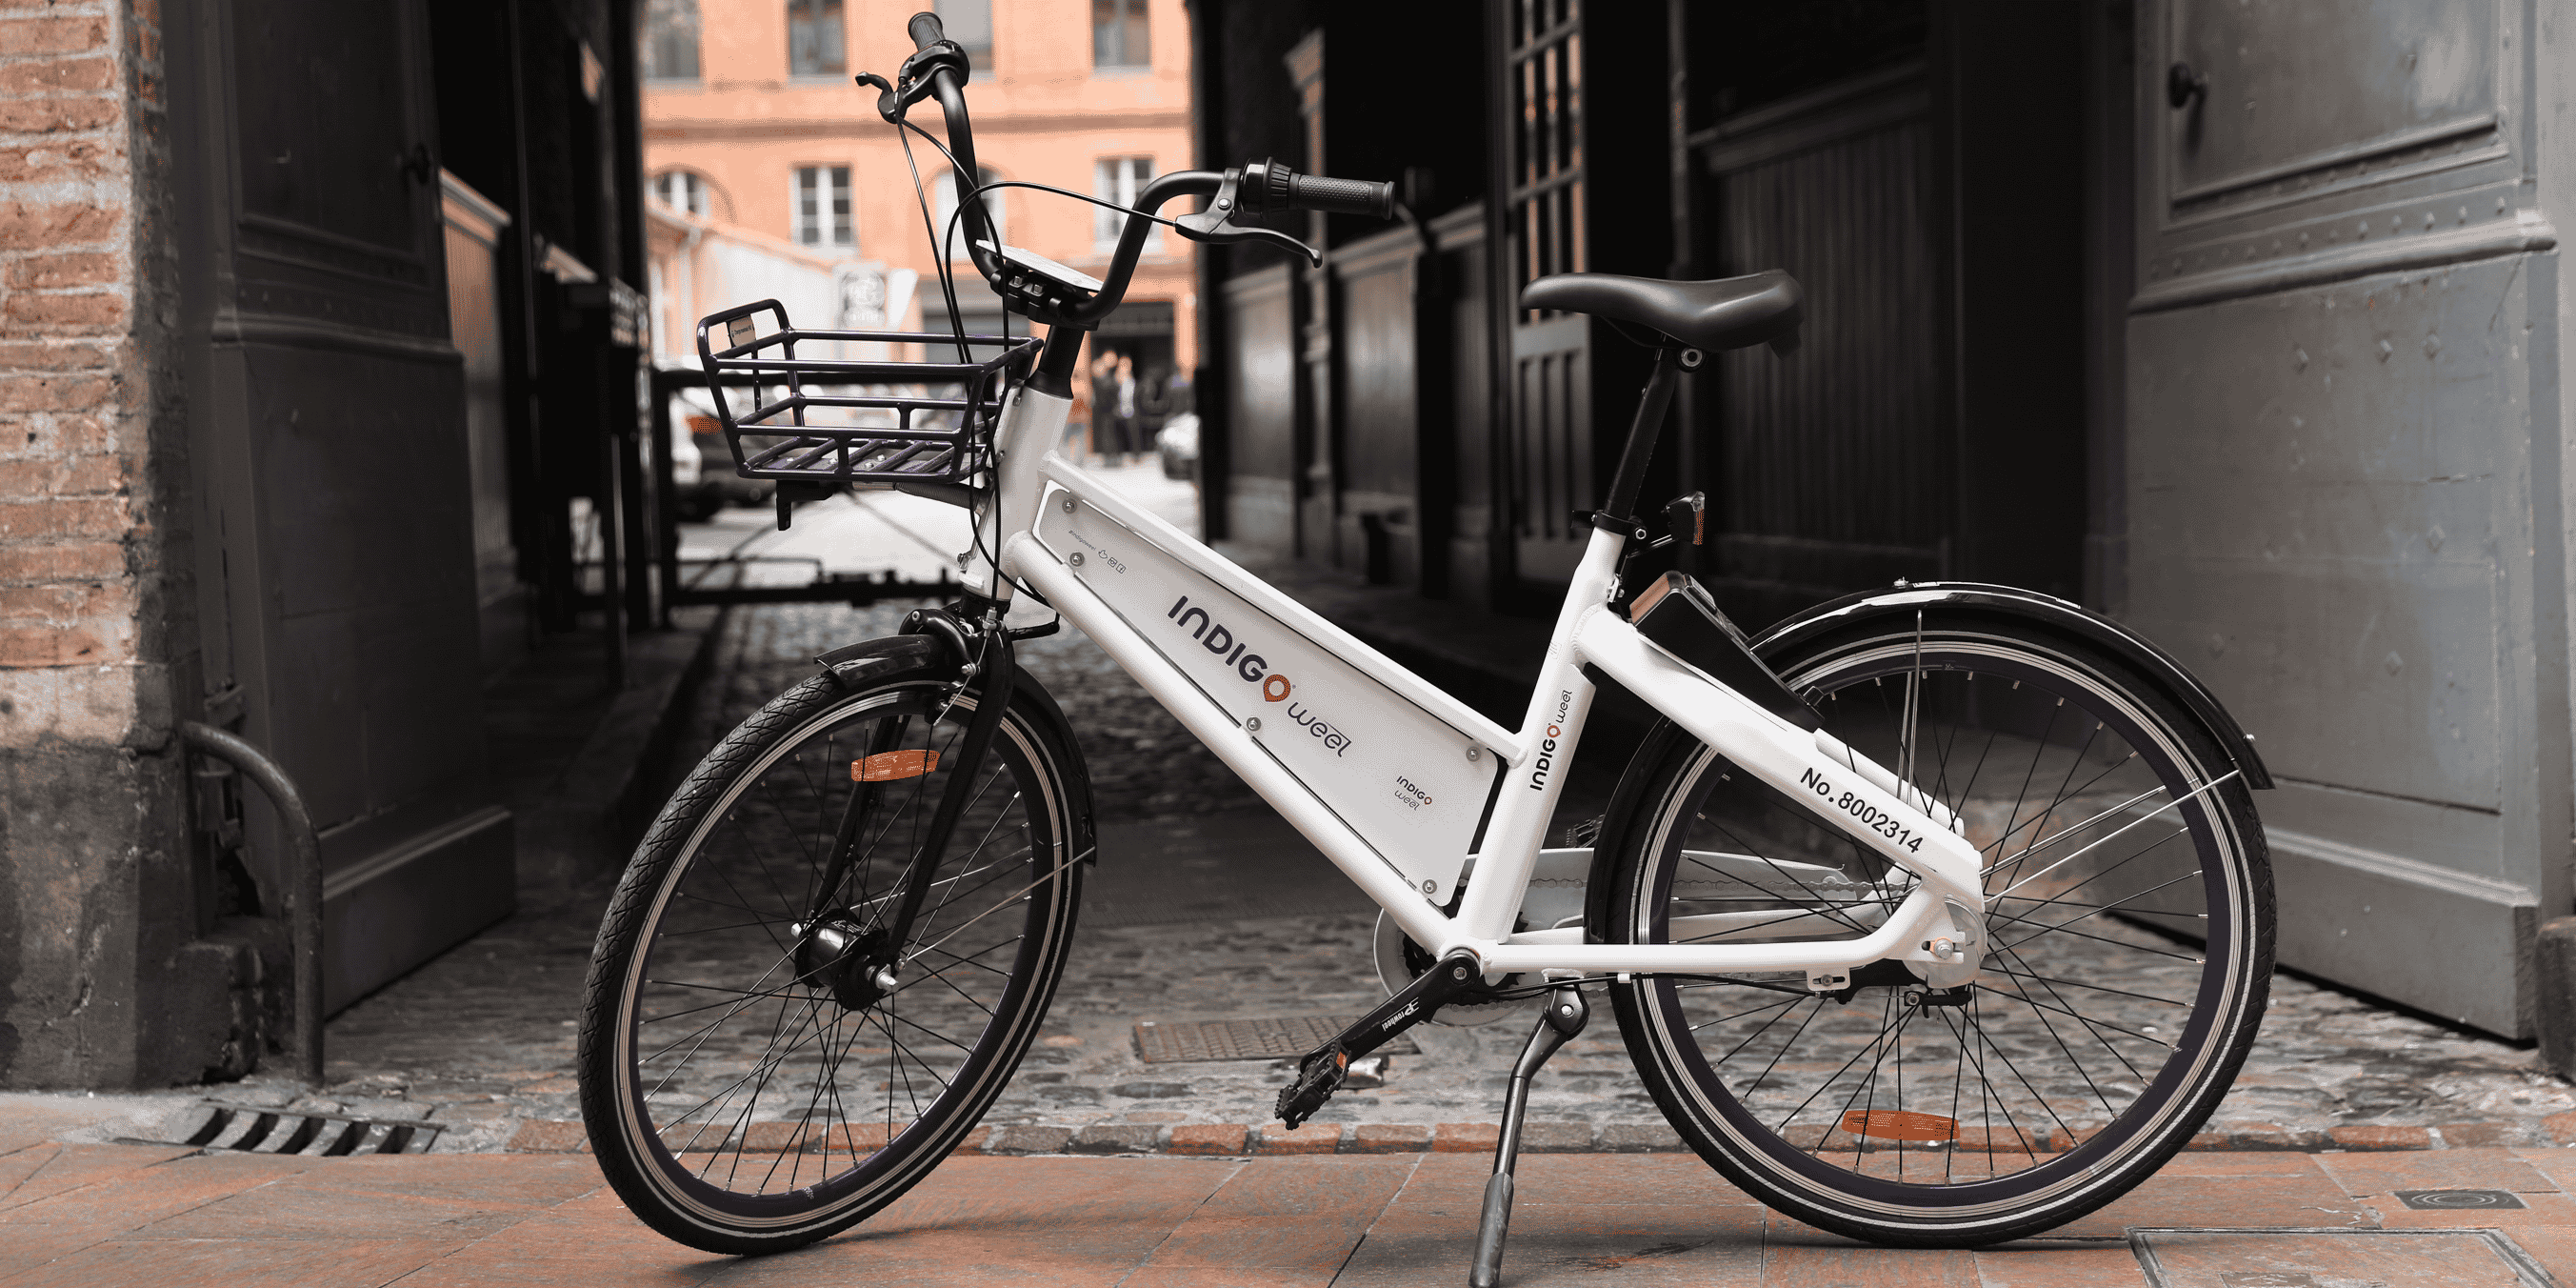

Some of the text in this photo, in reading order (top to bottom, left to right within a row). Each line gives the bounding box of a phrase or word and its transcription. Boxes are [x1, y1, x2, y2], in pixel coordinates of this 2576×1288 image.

[1168, 595, 1352, 757] INDIGO weel
[1396, 775, 1433, 806] INDIGO
[1529, 725, 1562, 792] INDIGO
